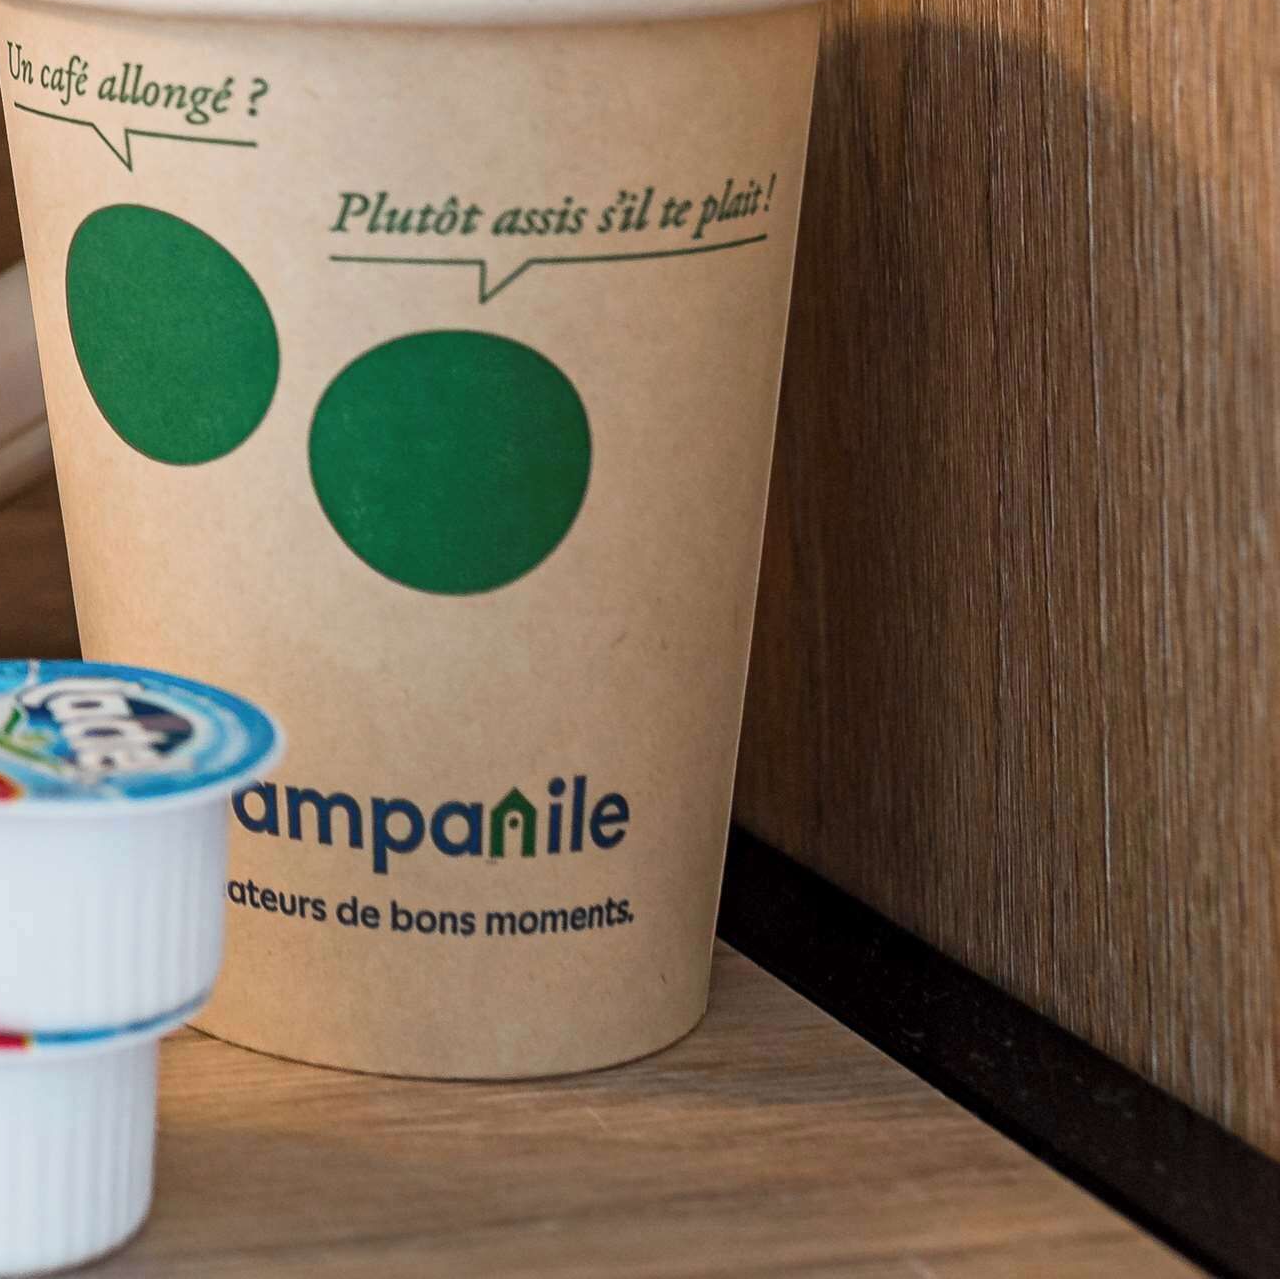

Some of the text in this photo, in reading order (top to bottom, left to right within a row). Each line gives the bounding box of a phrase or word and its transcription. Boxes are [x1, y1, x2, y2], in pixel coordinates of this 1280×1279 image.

[6, 40, 269, 125] Un café allongé ?
[329, 190, 484, 235] Plutôt
[490, 195, 589, 236] assis
[658, 195, 693, 231] te
[232, 775, 630, 875] ampanile
[226, 877, 635, 938] ateurs de bons moments.
